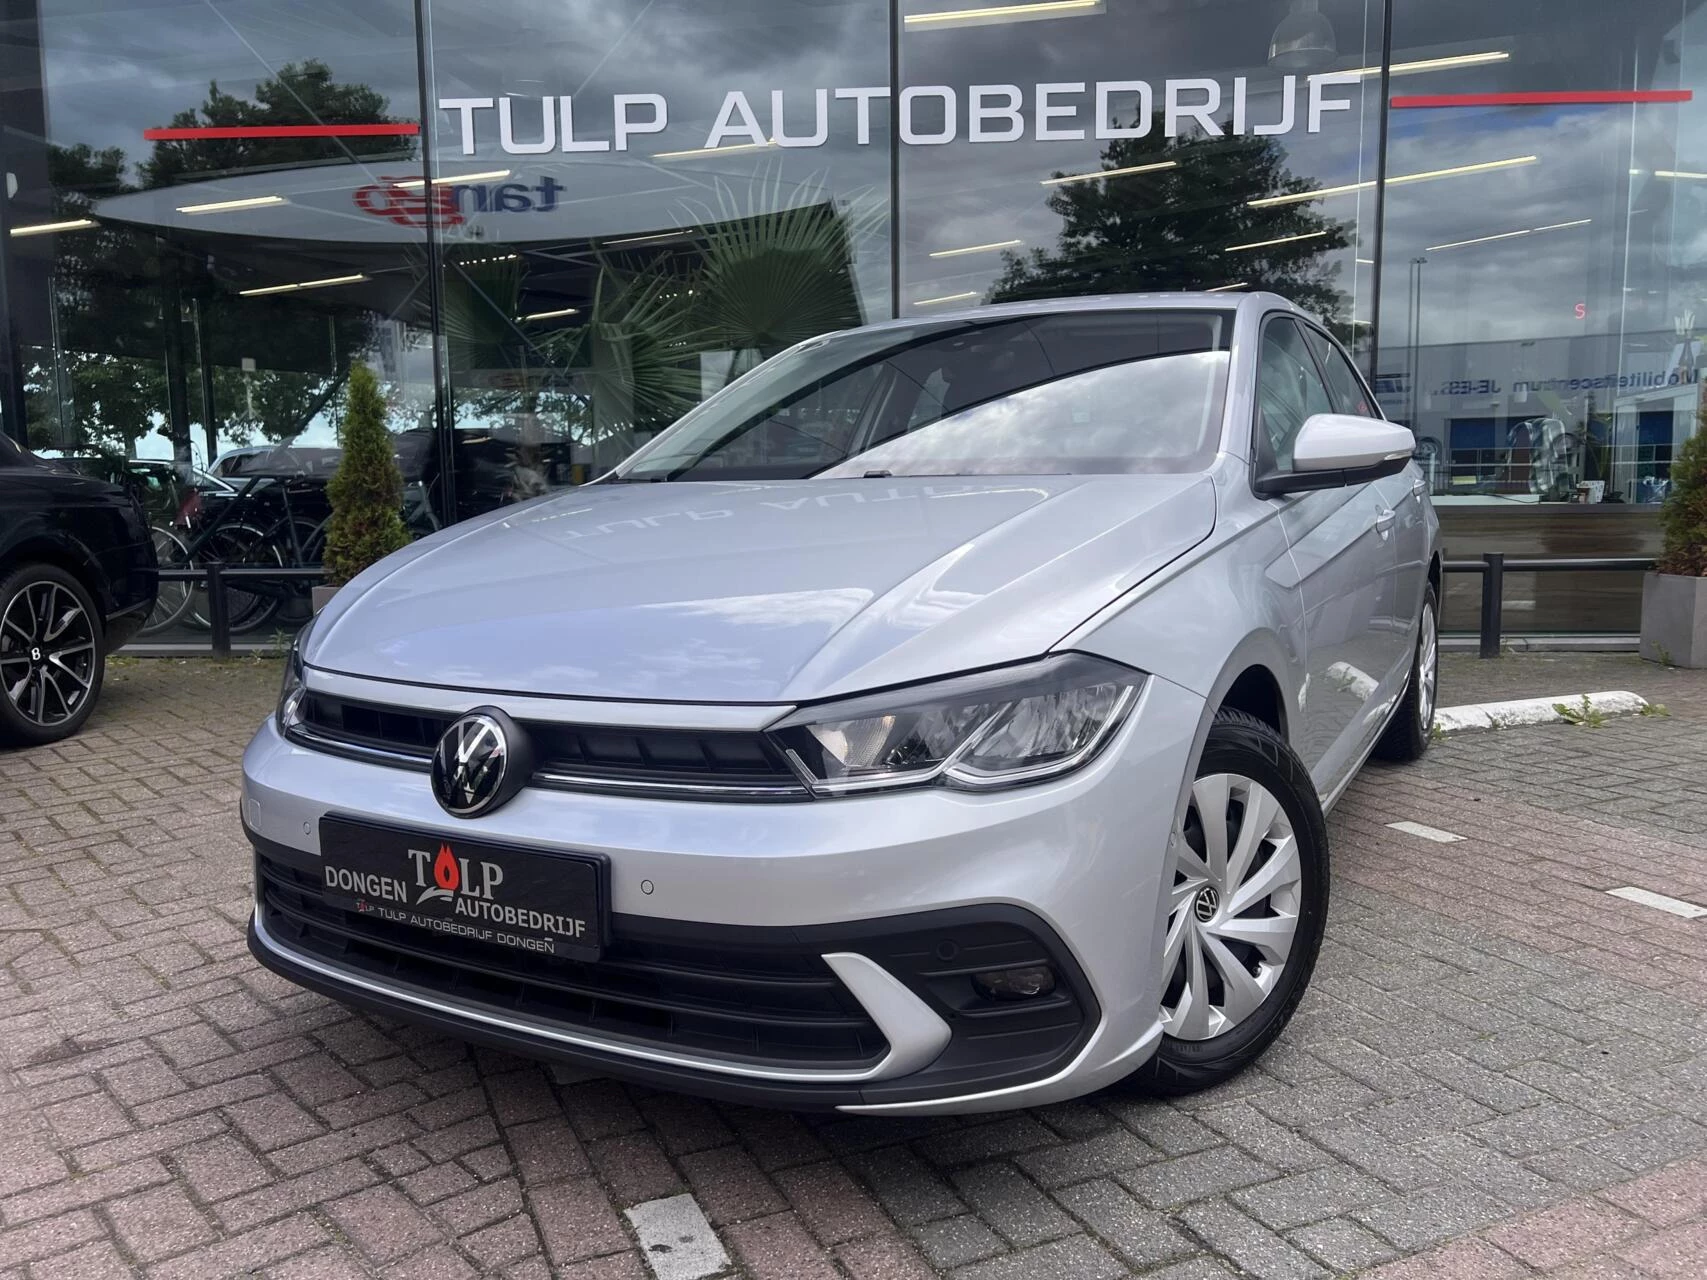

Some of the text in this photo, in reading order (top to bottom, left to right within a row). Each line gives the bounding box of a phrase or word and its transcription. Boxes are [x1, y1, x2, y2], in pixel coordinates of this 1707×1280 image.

[439, 75, 1361, 155] TULP AUTOBEDRIJF
[325, 866, 407, 902] DONGEN
[378, 907, 407, 921] TULP
[410, 915, 492, 940] AUTOBEDRIJF
[497, 936, 554, 953] DONGEN
[455, 897, 586, 938] AUTOBEDRIJF
